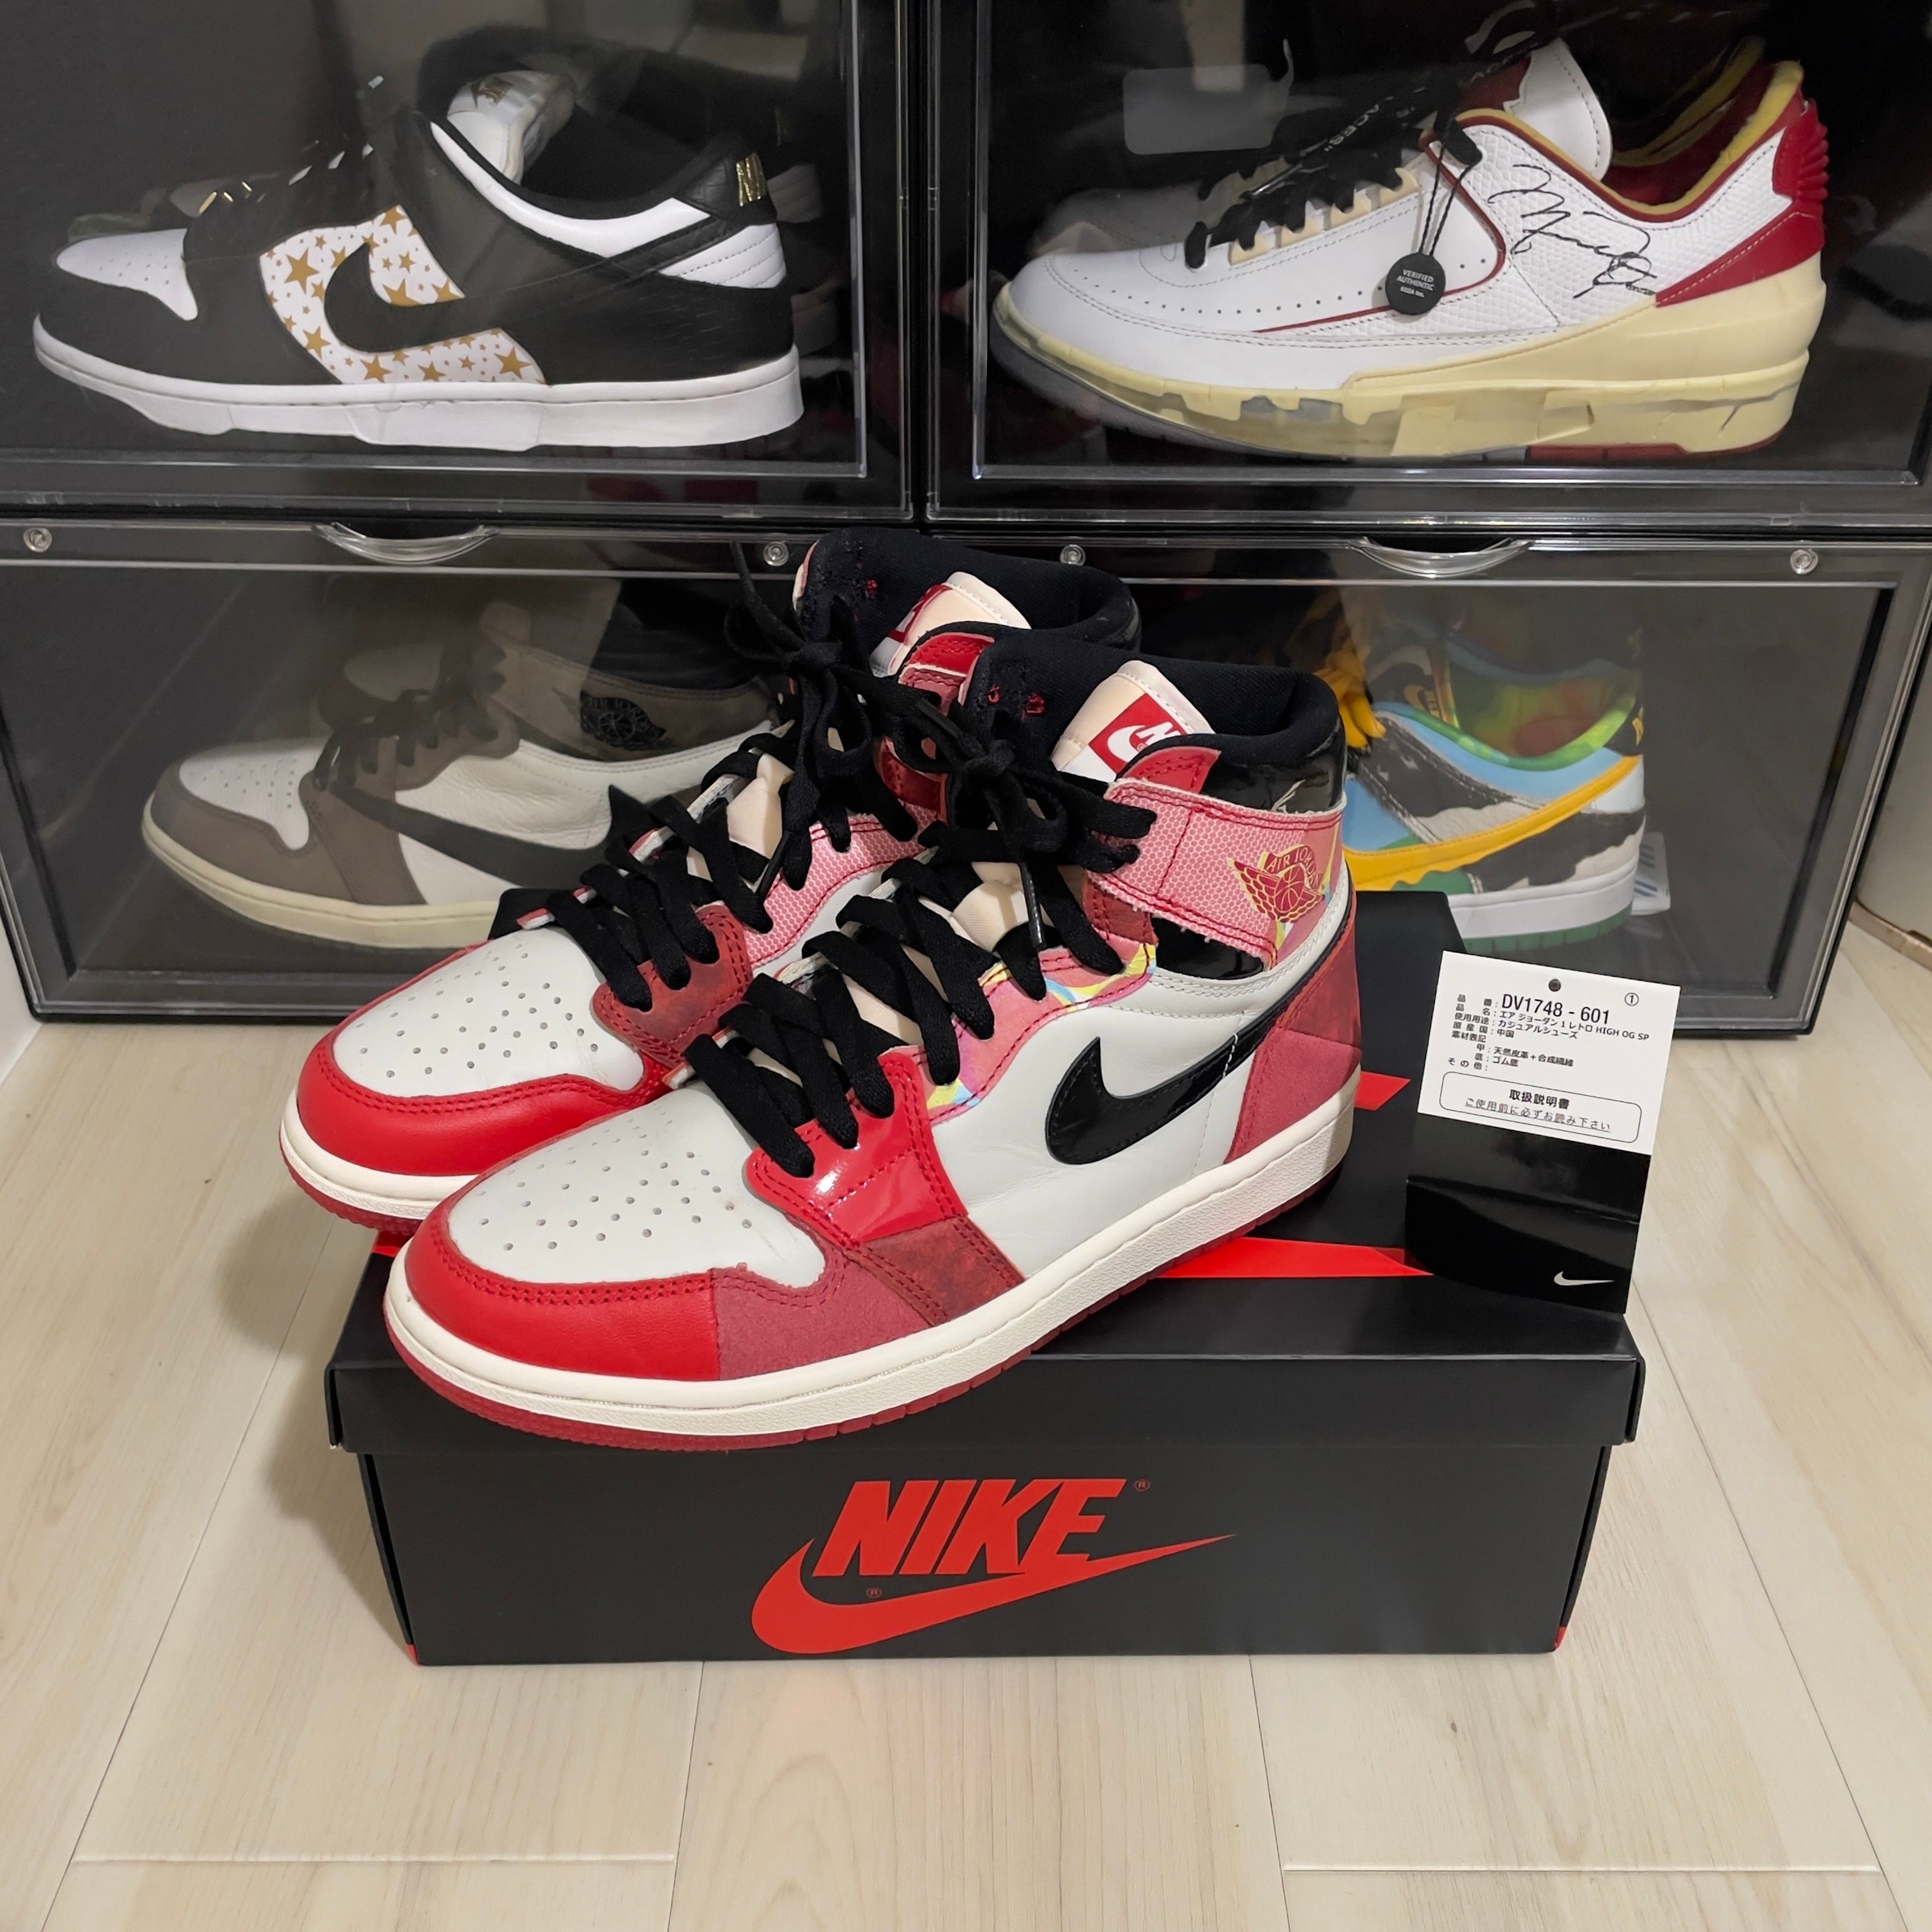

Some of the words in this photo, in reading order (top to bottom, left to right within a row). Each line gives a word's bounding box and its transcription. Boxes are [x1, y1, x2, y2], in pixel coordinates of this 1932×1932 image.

[1396, 275, 1434, 291] AUTHENTIC
[1402, 268, 1434, 283] VERIFIED
[1266, 854, 1291, 873] AIR
[1501, 993, 1563, 1017] DV1748
[1581, 1006, 1609, 1024] 601
[1497, 1028, 1515, 1038] 中国
[1596, 1026, 1620, 1036] HIGH
[1622, 1031, 1635, 1039] OG
[1508, 1089, 1570, 1110] 取扱説明書
[811, 1478, 1127, 1576] NIKE
